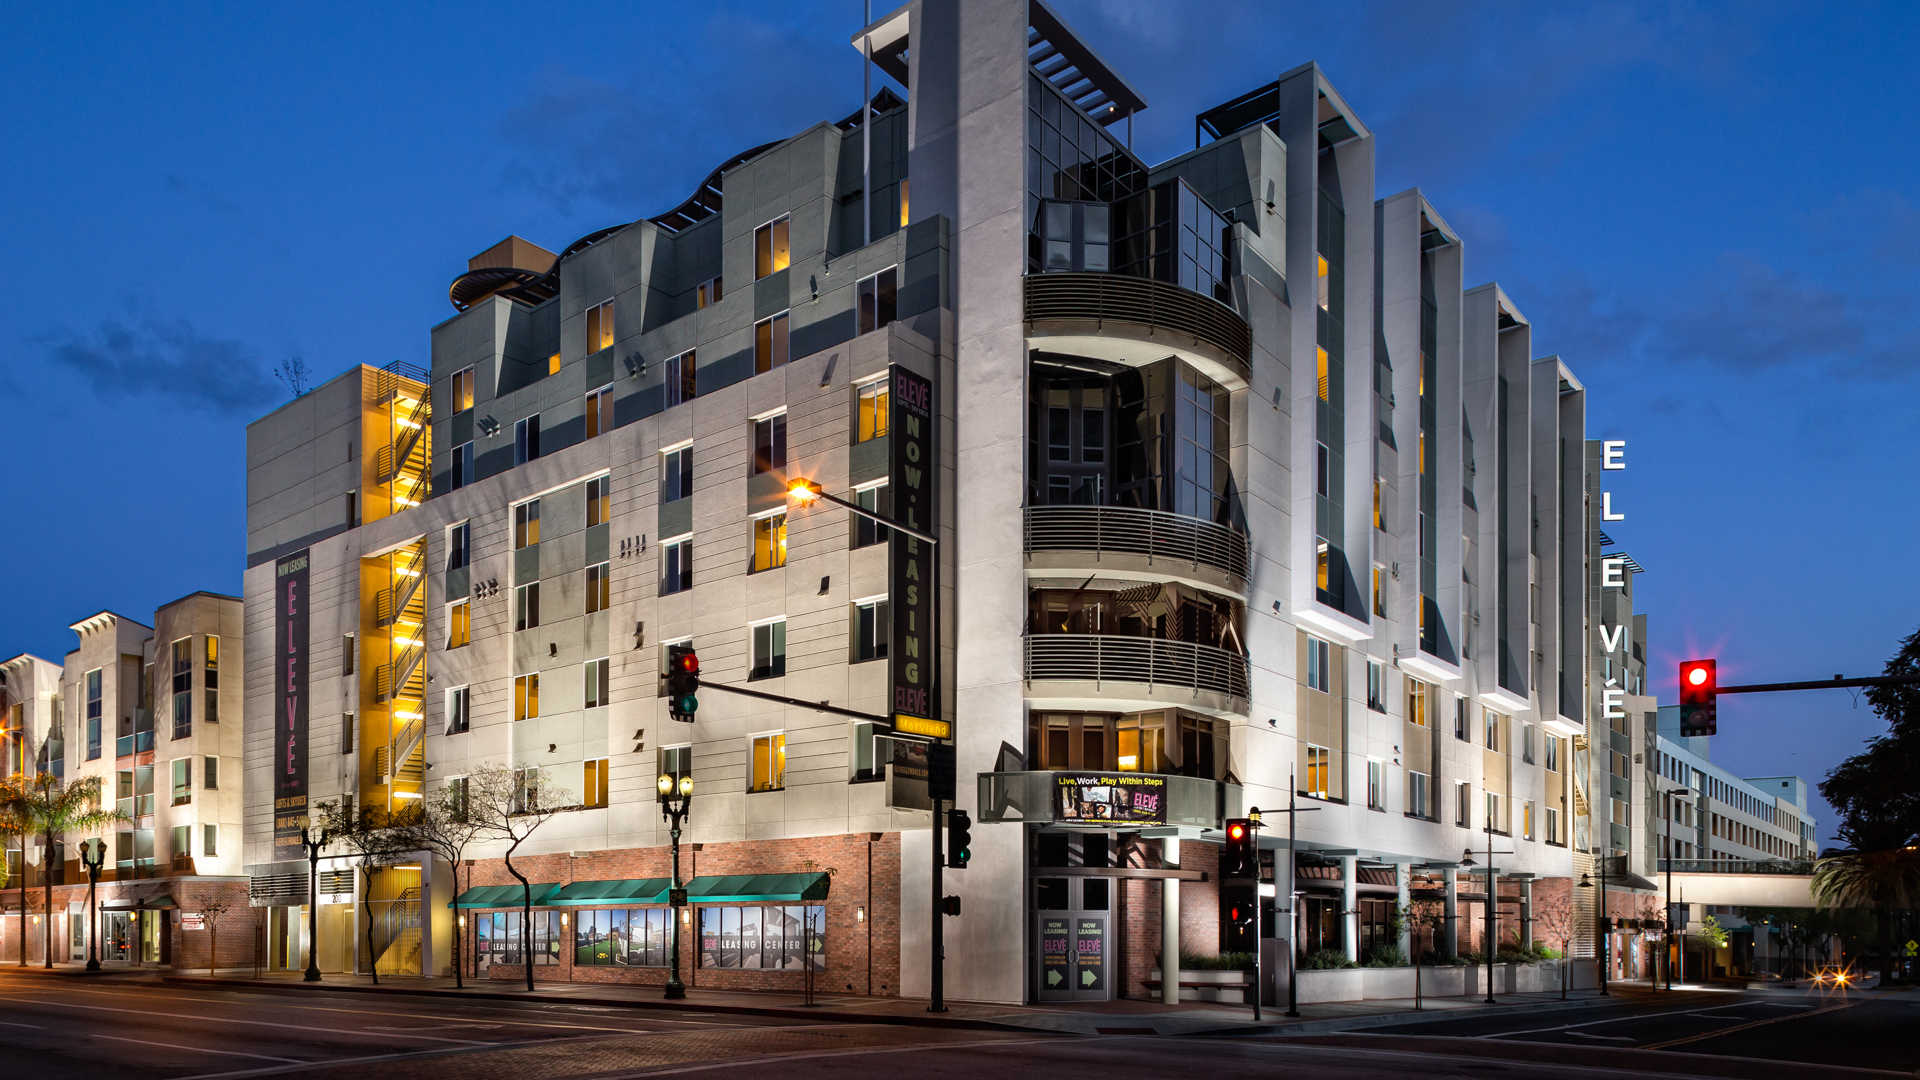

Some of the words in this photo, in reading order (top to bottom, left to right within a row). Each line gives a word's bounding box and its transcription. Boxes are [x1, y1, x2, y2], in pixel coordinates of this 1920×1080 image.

[904, 413, 922, 490] NOW
[905, 507, 920, 684] LEASING
[1101, 777, 1118, 787] Play
[1118, 777, 1143, 785] Within
[1143, 777, 1164, 787] Steps
[721, 940, 757, 950] LEASNG
